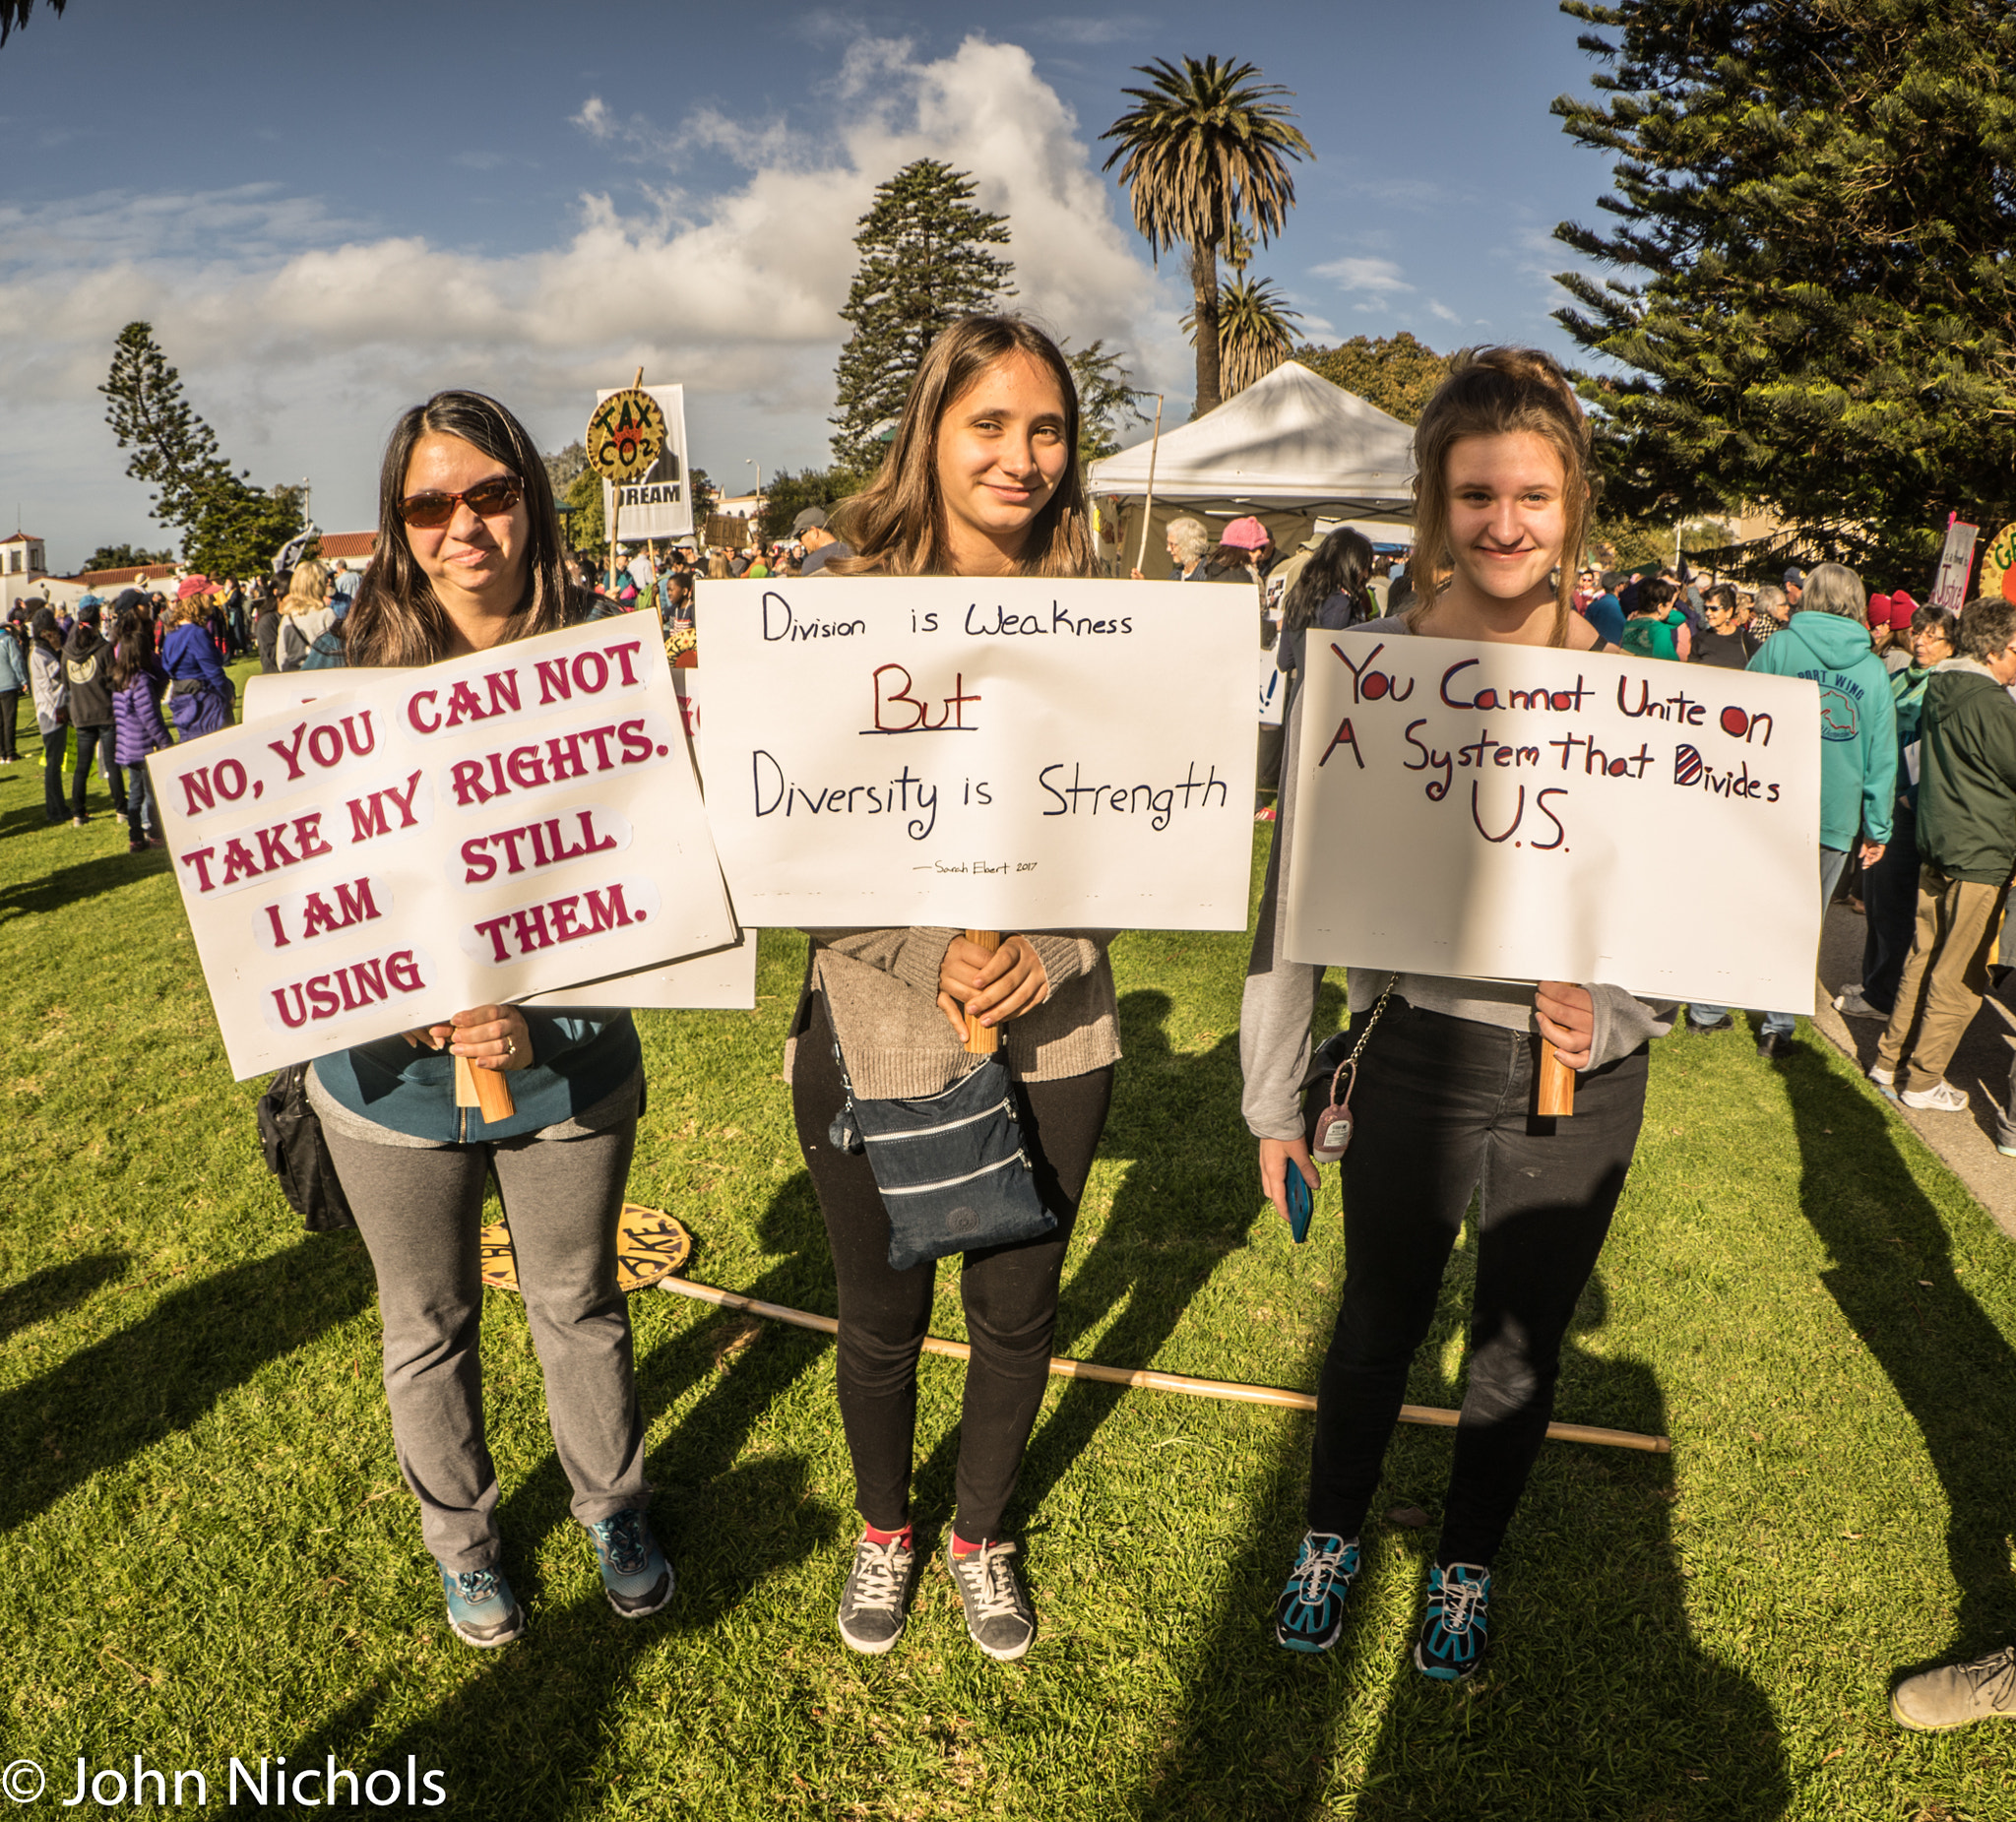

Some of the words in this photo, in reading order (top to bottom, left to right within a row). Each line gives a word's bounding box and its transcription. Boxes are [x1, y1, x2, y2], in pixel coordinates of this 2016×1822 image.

[595, 400, 653, 437] TAX
[612, 484, 680, 508] DREAM
[762, 592, 865, 642] Division
[912, 609, 938, 633] is
[965, 599, 1132, 636] Weakness
[872, 663, 981, 729] But
[1331, 643, 1415, 704] You
[1440, 659, 1596, 713] Cannot
[1617, 674, 1707, 725] Unite
[1797, 669, 1827, 683] PORT
[1835, 673, 1864, 701] WING
[178, 759, 264, 817] NO,
[268, 710, 375, 781] YOU
[408, 668, 522, 734] CAN
[534, 641, 641, 706] NOT
[1318, 718, 1365, 769] A
[1404, 719, 1540, 802] System
[1673, 740, 1780, 803] Divides
[181, 812, 333, 894] TAKE
[346, 769, 422, 844] MY
[450, 719, 668, 807] RIGHTS.
[752, 750, 937, 841] Diversity
[964, 778, 992, 805] is
[1039, 761, 1227, 832] Strength
[1469, 777, 1570, 859] U.S.
[264, 905, 291, 948] I
[303, 877, 382, 939] AM
[461, 810, 617, 885] STILL
[973, 861, 1010, 874] Ebert
[1016, 862, 1038, 872] 2017
[271, 950, 426, 1029] USING
[474, 883, 647, 964] THEM.
